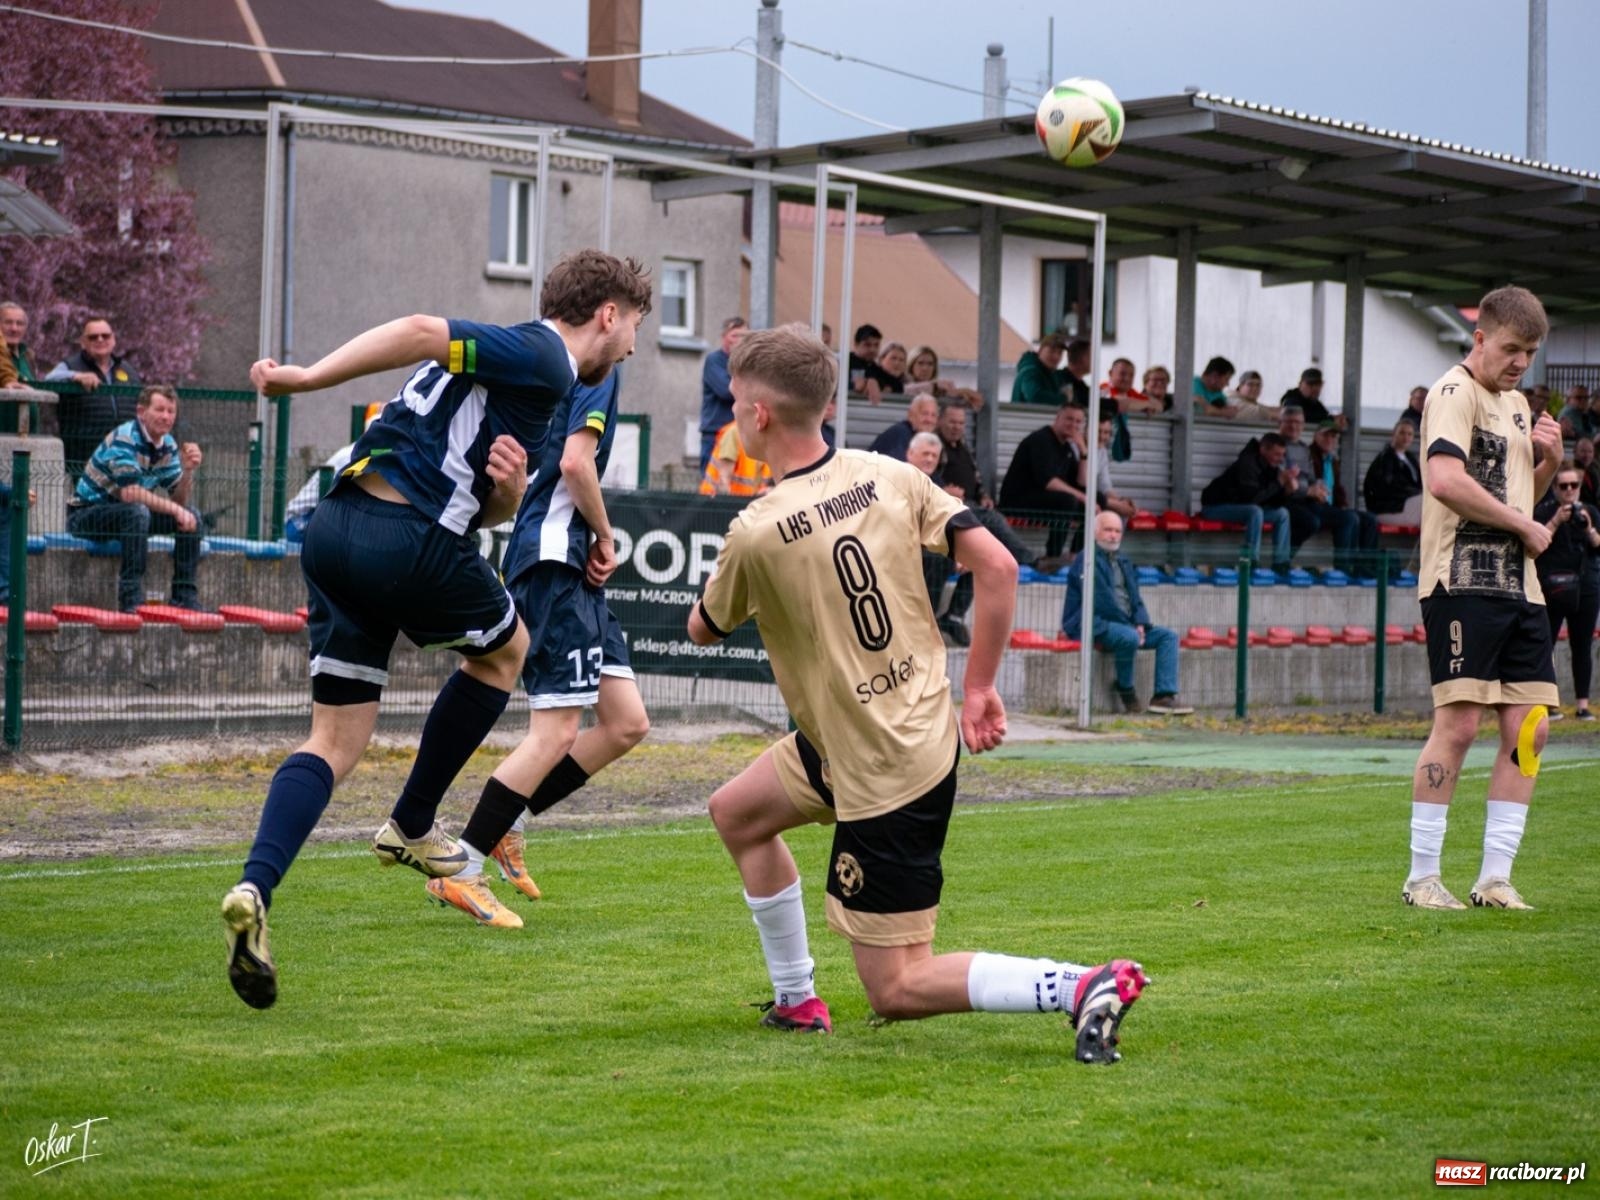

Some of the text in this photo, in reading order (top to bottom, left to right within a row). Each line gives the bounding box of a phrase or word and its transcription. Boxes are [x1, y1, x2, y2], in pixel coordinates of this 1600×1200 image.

[591, 527, 725, 585] POR
[604, 588, 699, 606] artner MACRON
[833, 535, 893, 651] 8
[1450, 620, 1463, 656] 9
[567, 646, 603, 688] 13
[856, 653, 914, 704] safer
